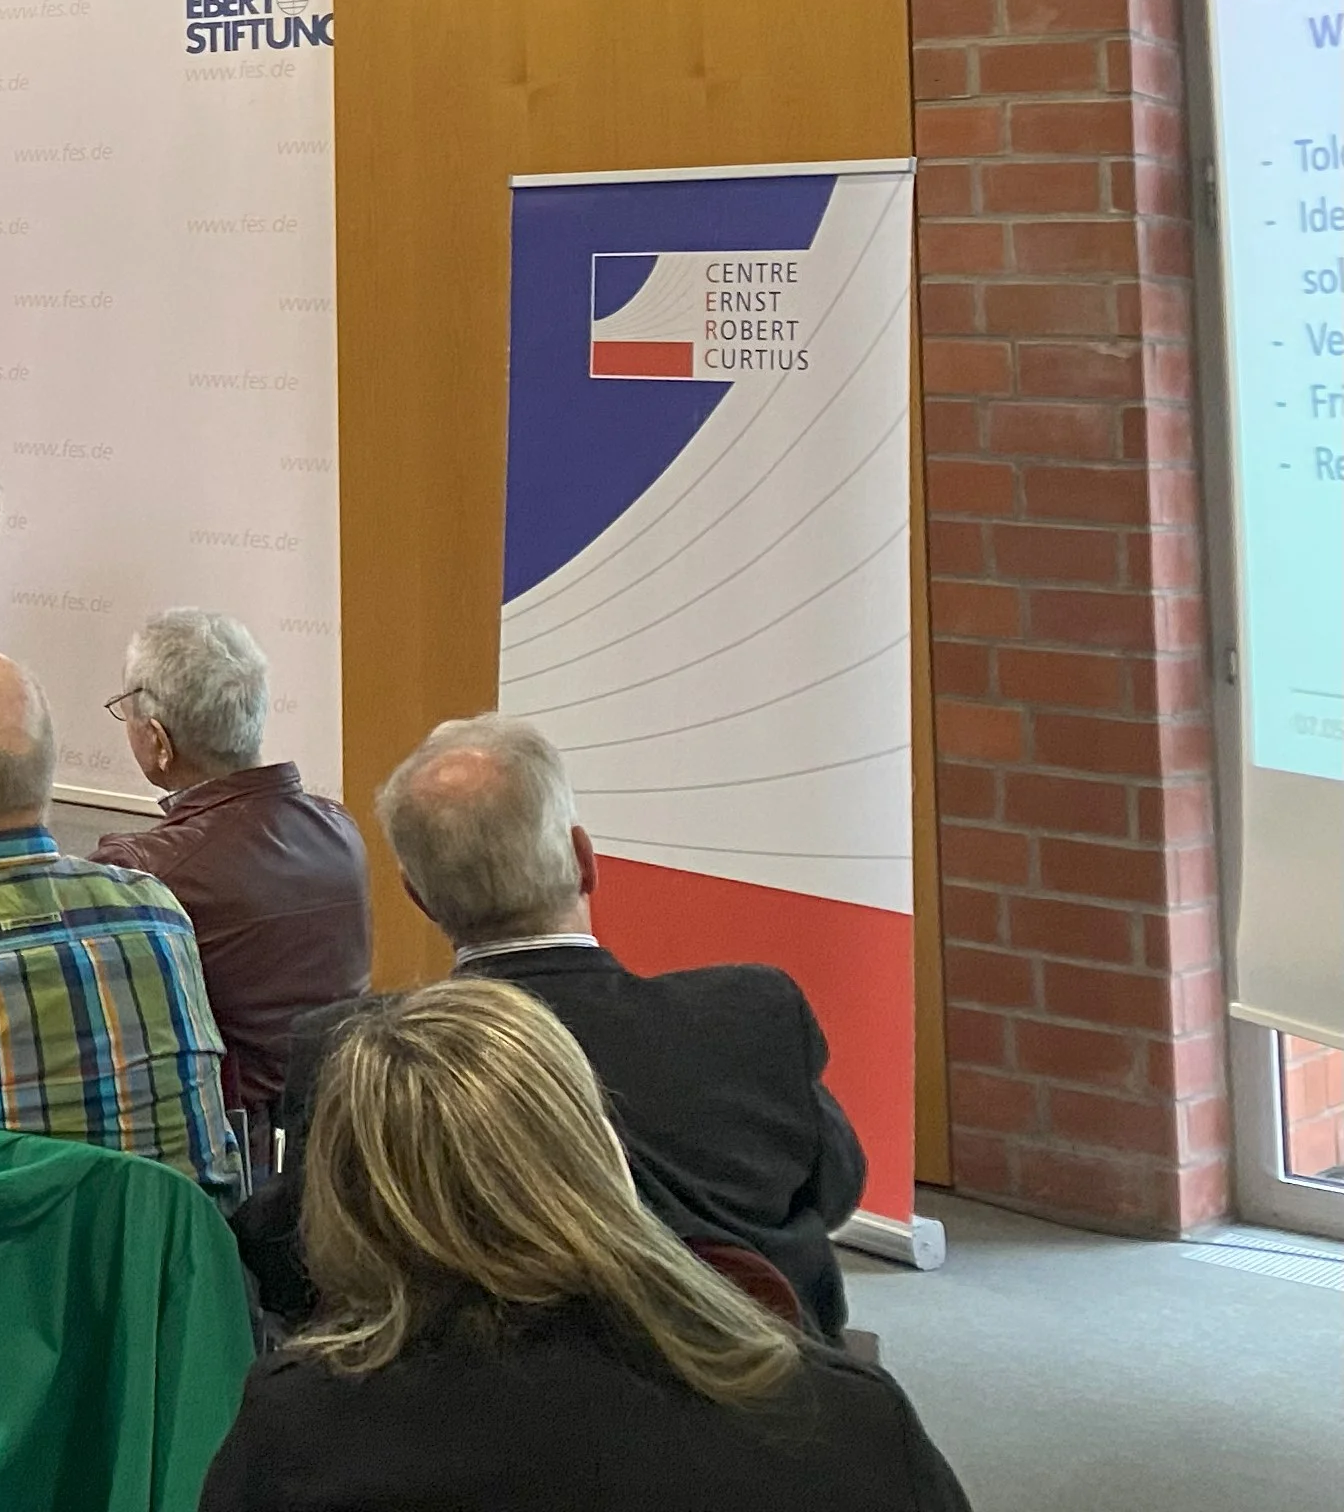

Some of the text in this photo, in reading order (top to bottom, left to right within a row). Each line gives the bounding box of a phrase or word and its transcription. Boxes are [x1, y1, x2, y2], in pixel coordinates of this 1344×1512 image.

[184, 60, 295, 81] www.fes.de
[14, 144, 112, 162] www.fes.de
[187, 214, 298, 234] www.fes.de
[706, 262, 798, 284] CENTRE
[14, 290, 112, 308] www.fes.de
[705, 291, 782, 313] ERNST
[705, 319, 799, 341] ROBERT
[704, 348, 810, 371] CURTIUS
[189, 370, 298, 391] www.fes.de
[14, 441, 112, 461] www.fes.de
[190, 527, 298, 551] www.fes.de
[16, 590, 112, 613] www.fes.de
